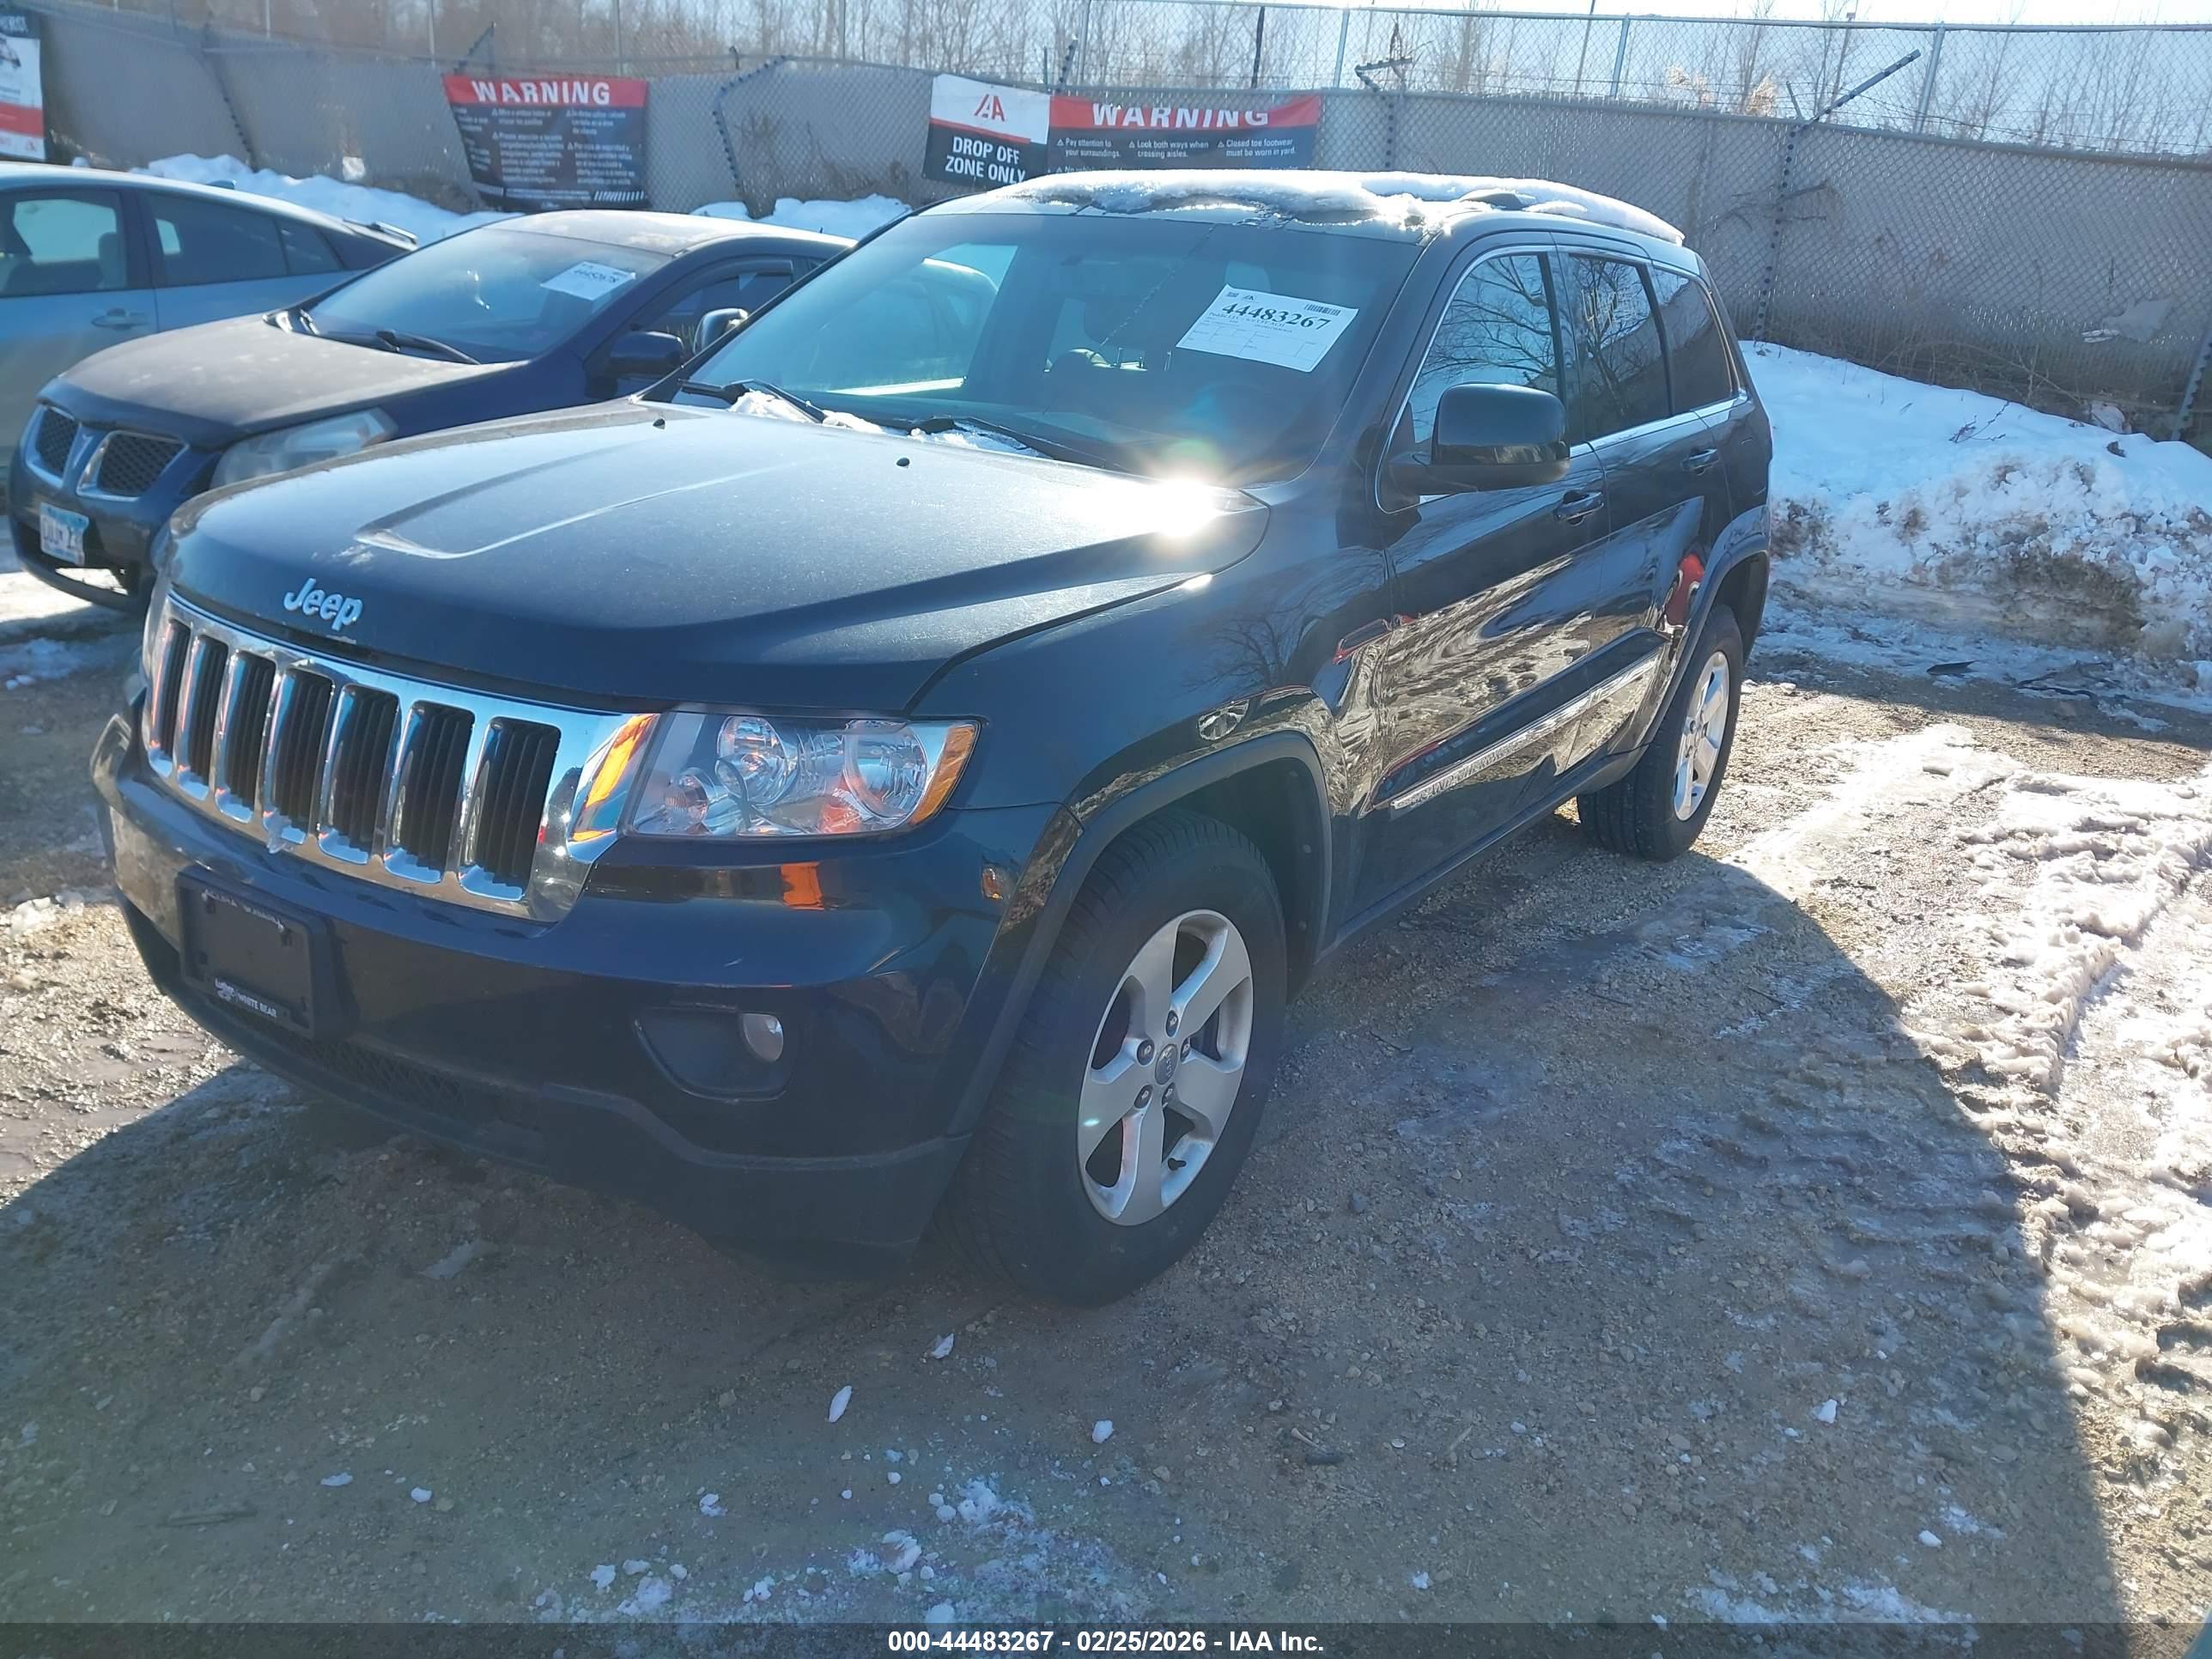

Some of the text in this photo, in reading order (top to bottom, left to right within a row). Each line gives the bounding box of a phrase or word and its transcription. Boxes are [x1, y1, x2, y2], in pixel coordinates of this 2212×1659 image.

[471, 80, 611, 105] WARNING
[1092, 103, 1268, 128] WARNING
[952, 136, 1020, 165] DROP OFF
[1066, 137, 1077, 148] Pay
[1137, 140, 1152, 149] Look
[1153, 140, 1168, 149] both
[1189, 140, 1209, 149] when
[1226, 139, 1249, 148] Closed
[1264, 138, 1293, 147] footwear
[1244, 148, 1254, 156] be
[1280, 146, 1297, 156] yard.
[1138, 149, 1188, 160] crossing aisles.
[945, 155, 1026, 184] ZONE ONLY
[1222, 303, 1331, 331] 44483267
[283, 577, 363, 631] Jeep
[259, 1002, 276, 1018] BEAR
